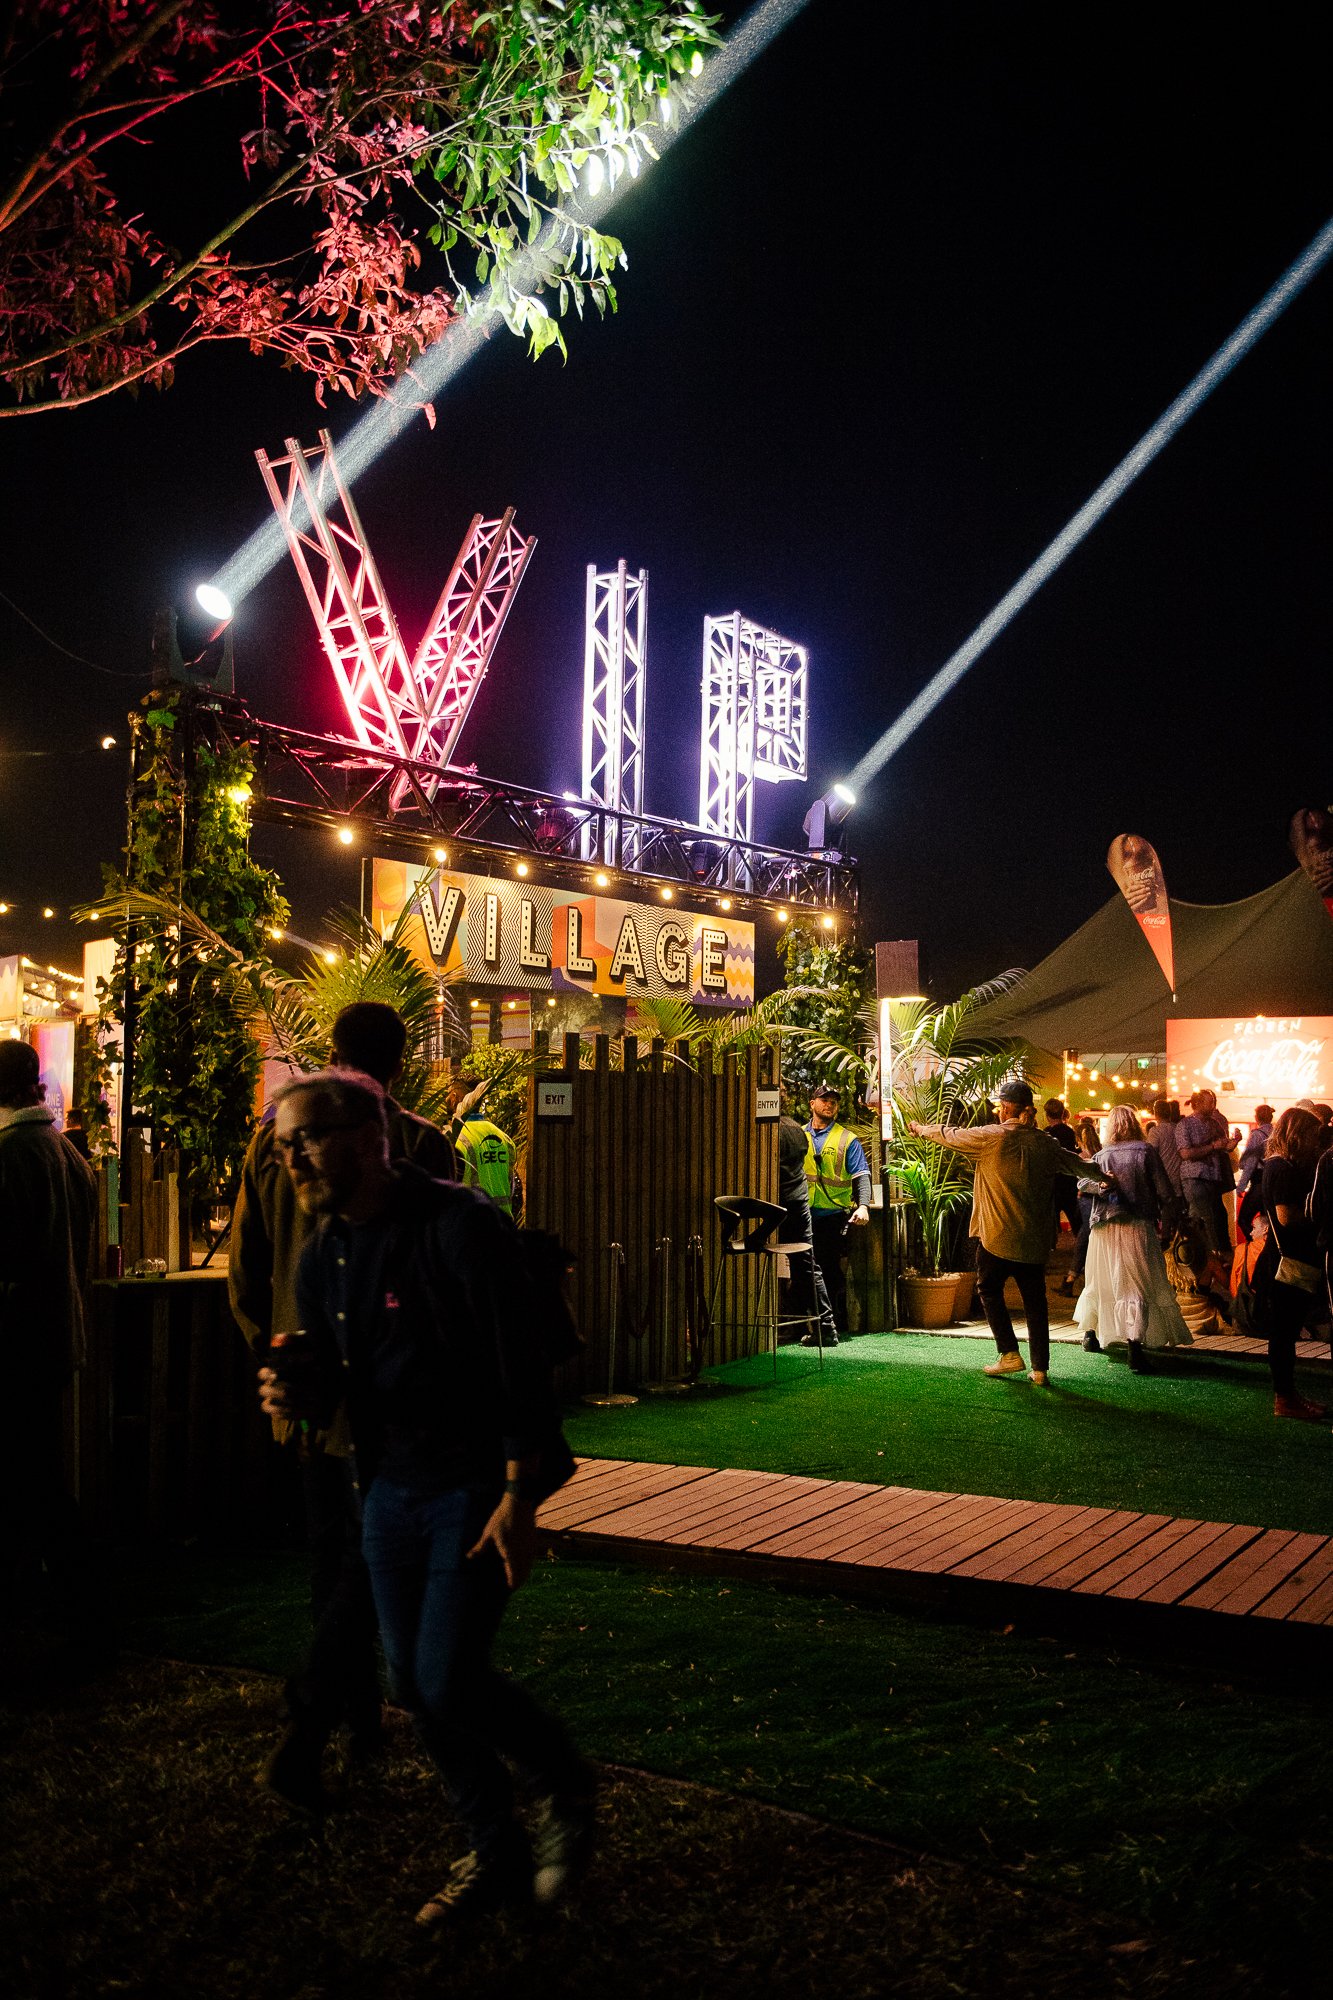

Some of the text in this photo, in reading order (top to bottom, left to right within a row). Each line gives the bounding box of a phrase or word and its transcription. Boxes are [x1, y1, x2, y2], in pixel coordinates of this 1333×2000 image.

[414, 880, 727, 990] VILLAGE
[545, 1094, 566, 1105] EXIT
[757, 1100, 779, 1109] ENTRY
